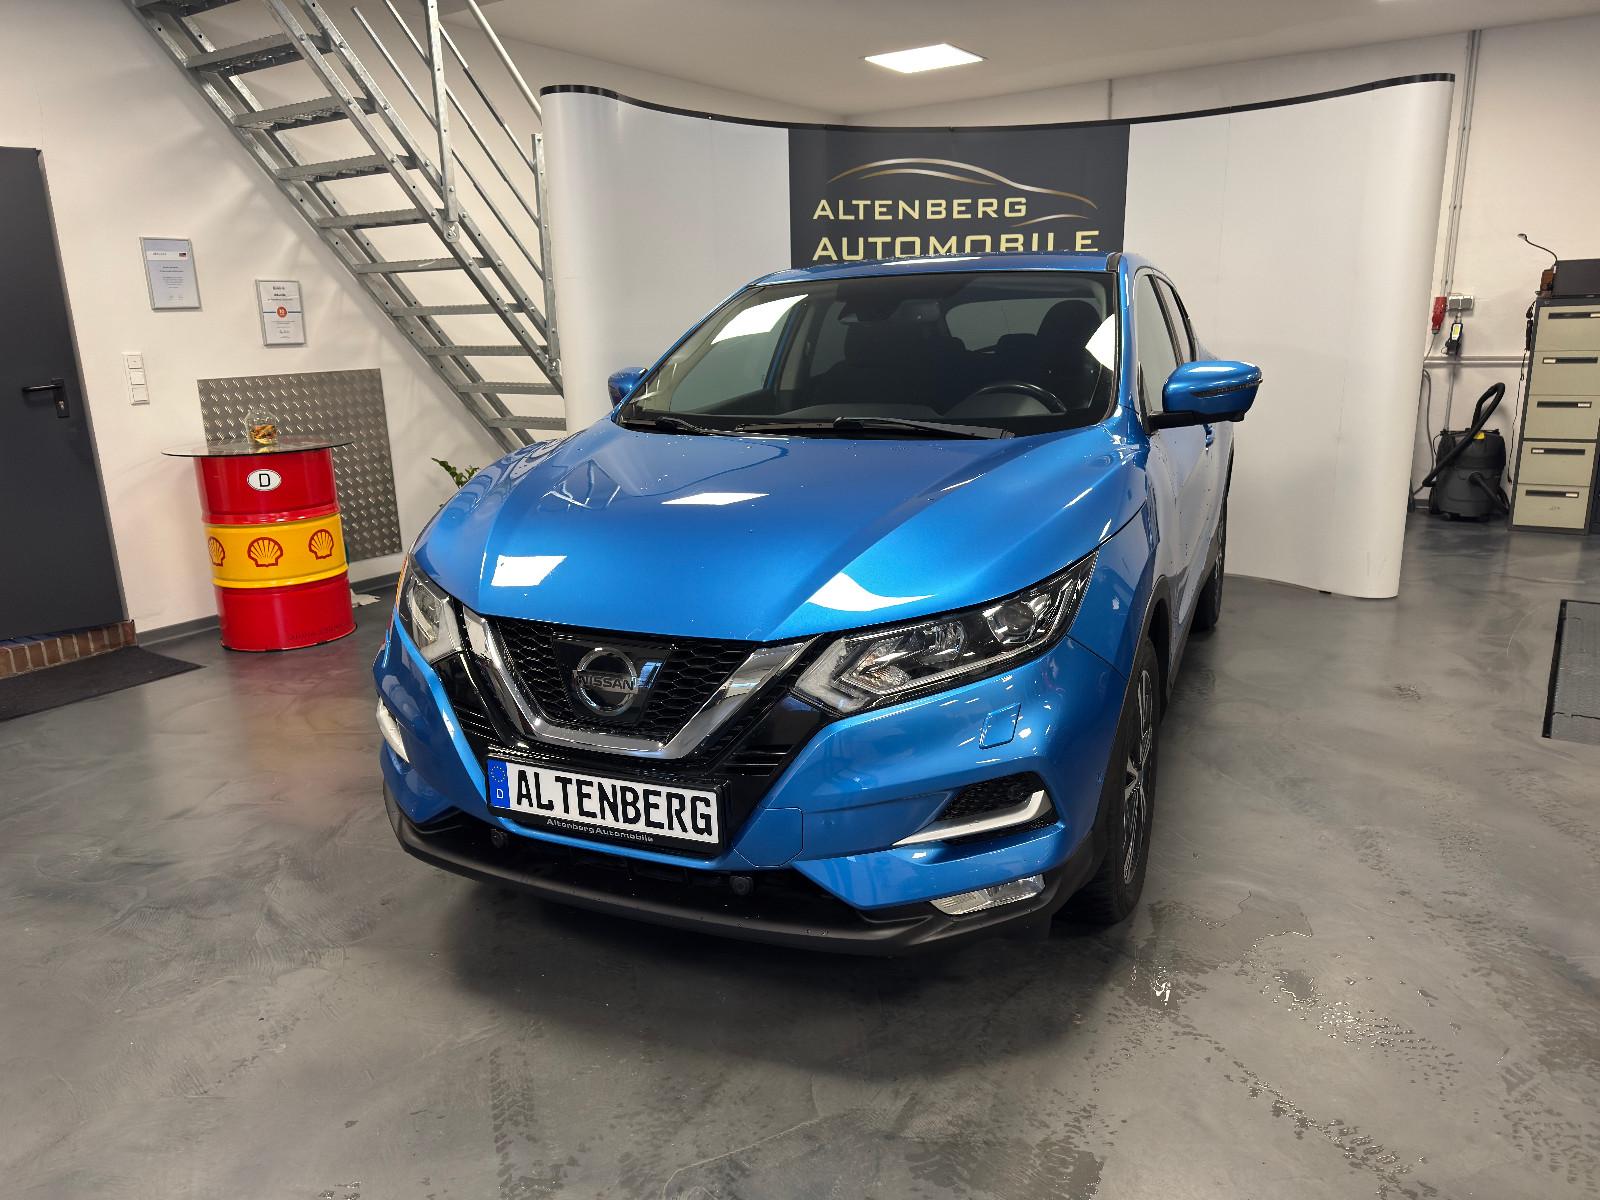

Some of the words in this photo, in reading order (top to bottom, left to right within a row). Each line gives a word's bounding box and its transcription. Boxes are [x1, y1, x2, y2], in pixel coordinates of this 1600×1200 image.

[813, 197, 1027, 220] ALTENBERG
[259, 473, 271, 487] D
[581, 674, 634, 691] NISSAN
[496, 788, 504, 799] D
[516, 769, 713, 837] ALTENBERG
